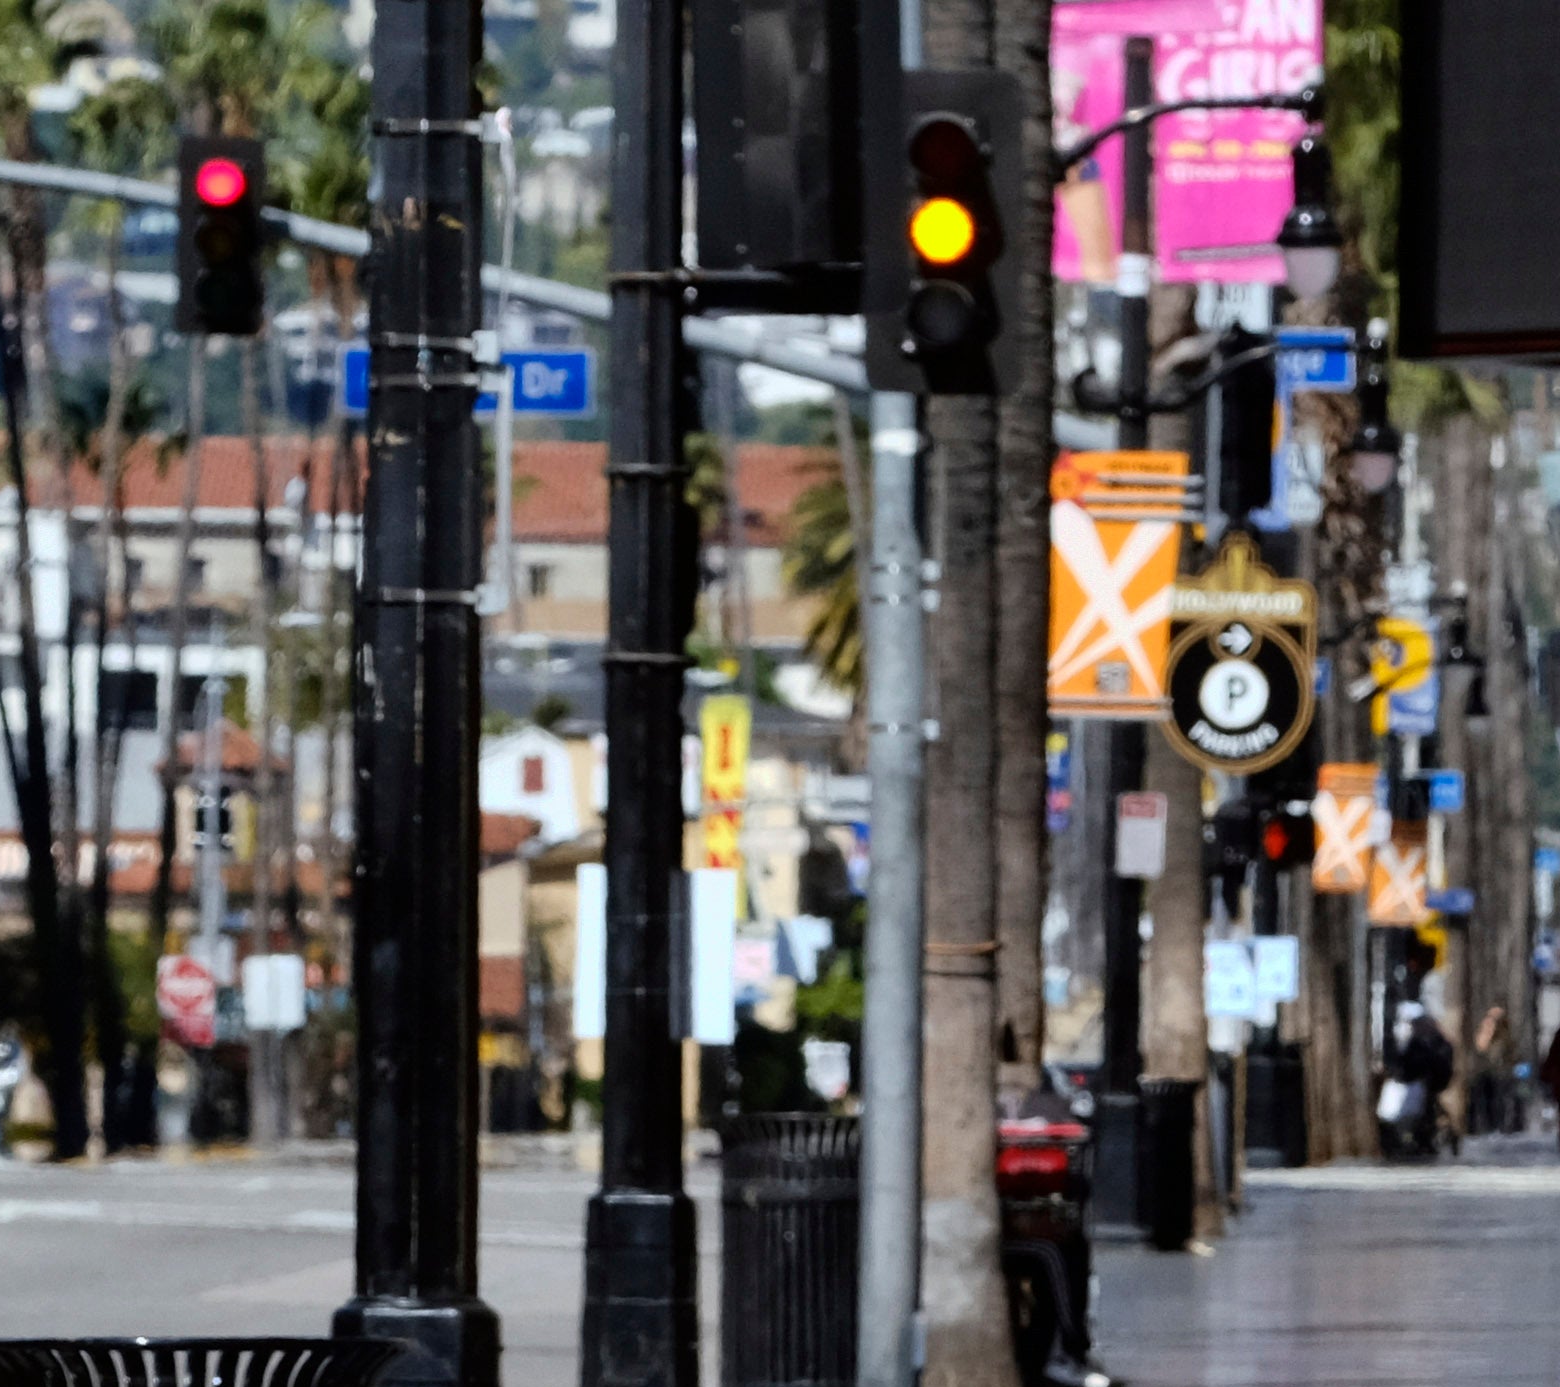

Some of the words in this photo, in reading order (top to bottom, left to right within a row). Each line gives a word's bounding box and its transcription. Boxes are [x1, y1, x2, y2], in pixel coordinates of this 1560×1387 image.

[521, 361, 568, 399] Dr
[1172, 590, 1303, 616] HOLLYWOOD
[1226, 674, 1248, 710] P
[1187, 718, 1280, 757] PARKING
